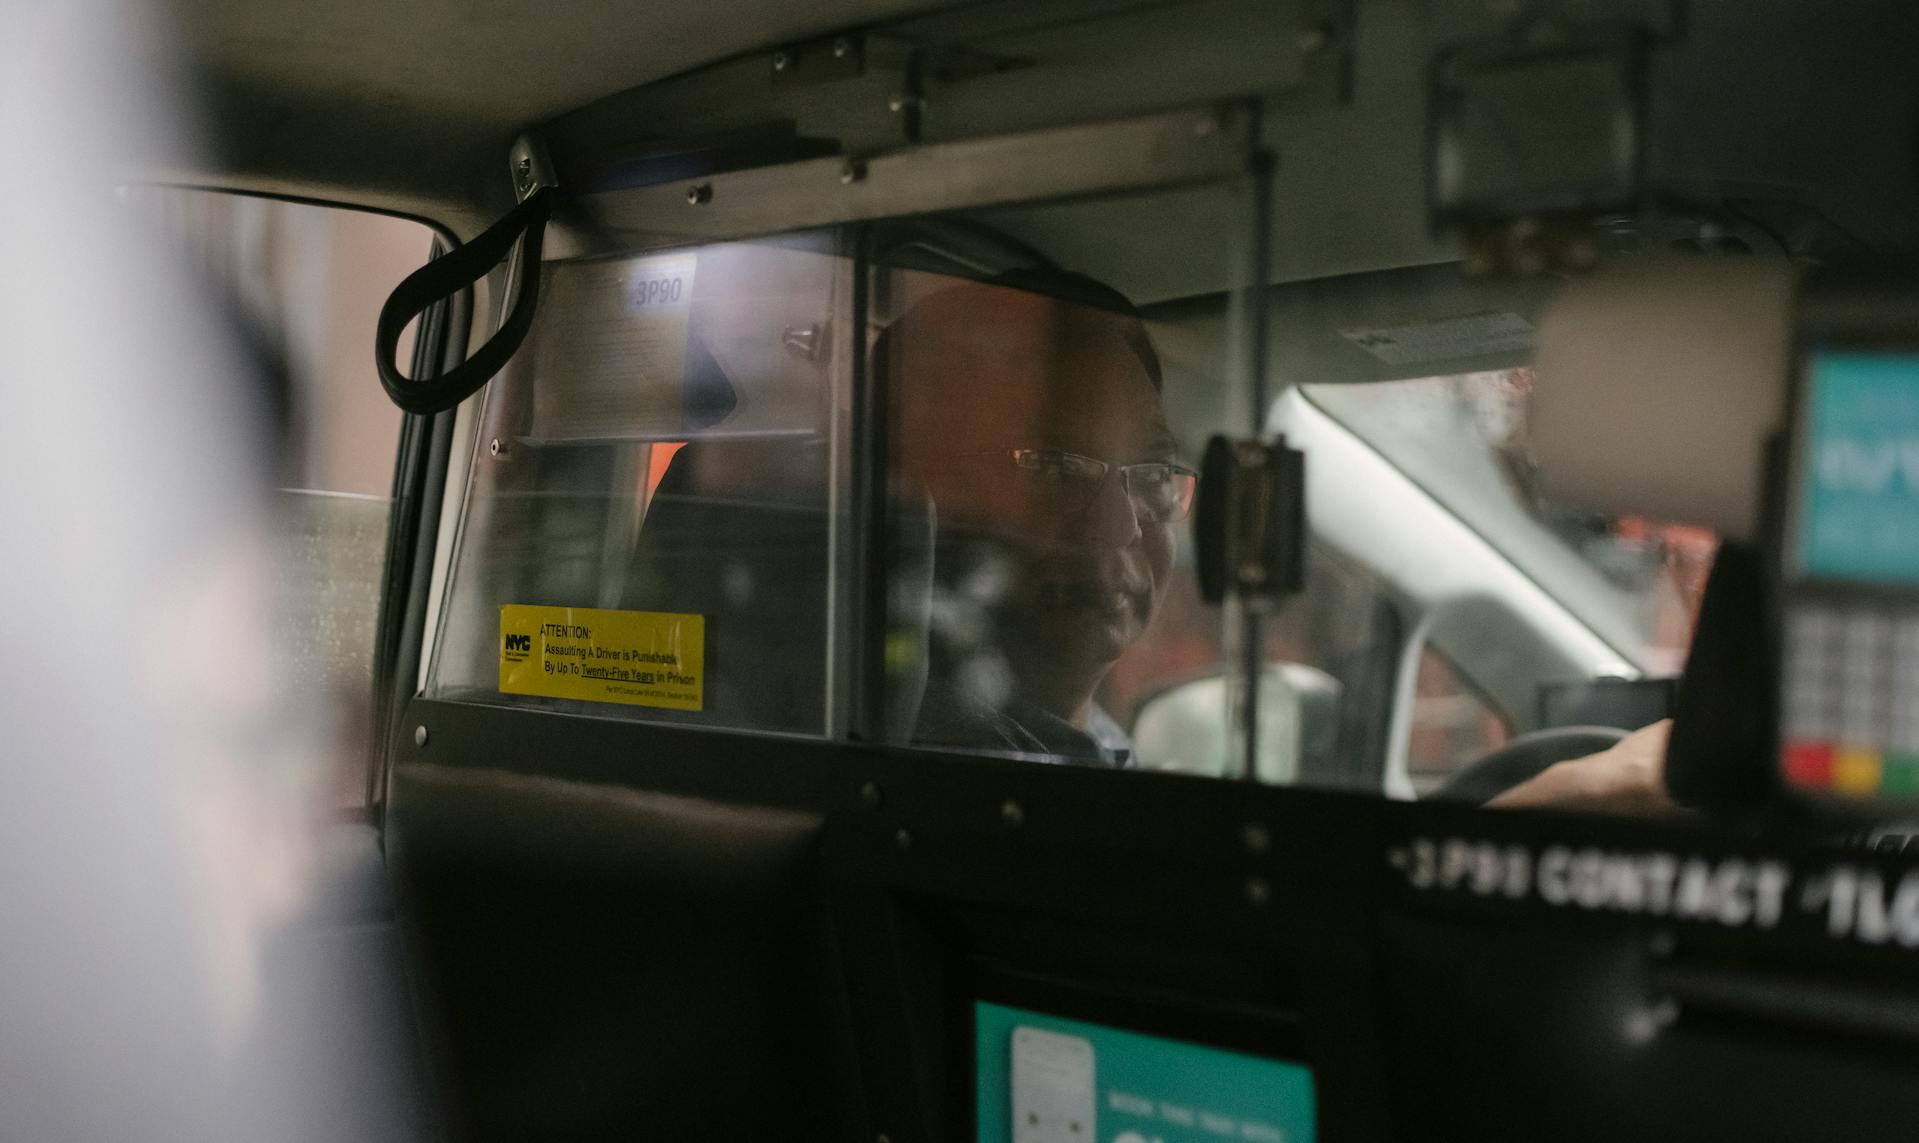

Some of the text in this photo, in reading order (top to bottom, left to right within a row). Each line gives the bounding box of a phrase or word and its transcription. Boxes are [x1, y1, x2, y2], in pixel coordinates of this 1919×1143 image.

[636, 277, 682, 306] 3P90
[505, 633, 531, 651] NYC
[540, 623, 592, 640] ATTENTION:
[544, 643, 586, 660] Assaulting
[588, 646, 595, 658] A
[596, 647, 622, 660] Driver
[622, 649, 631, 661] is
[544, 660, 696, 685] By Up To Twenty-Five Years in Prison
[1536, 844, 1786, 928] CONTACT
